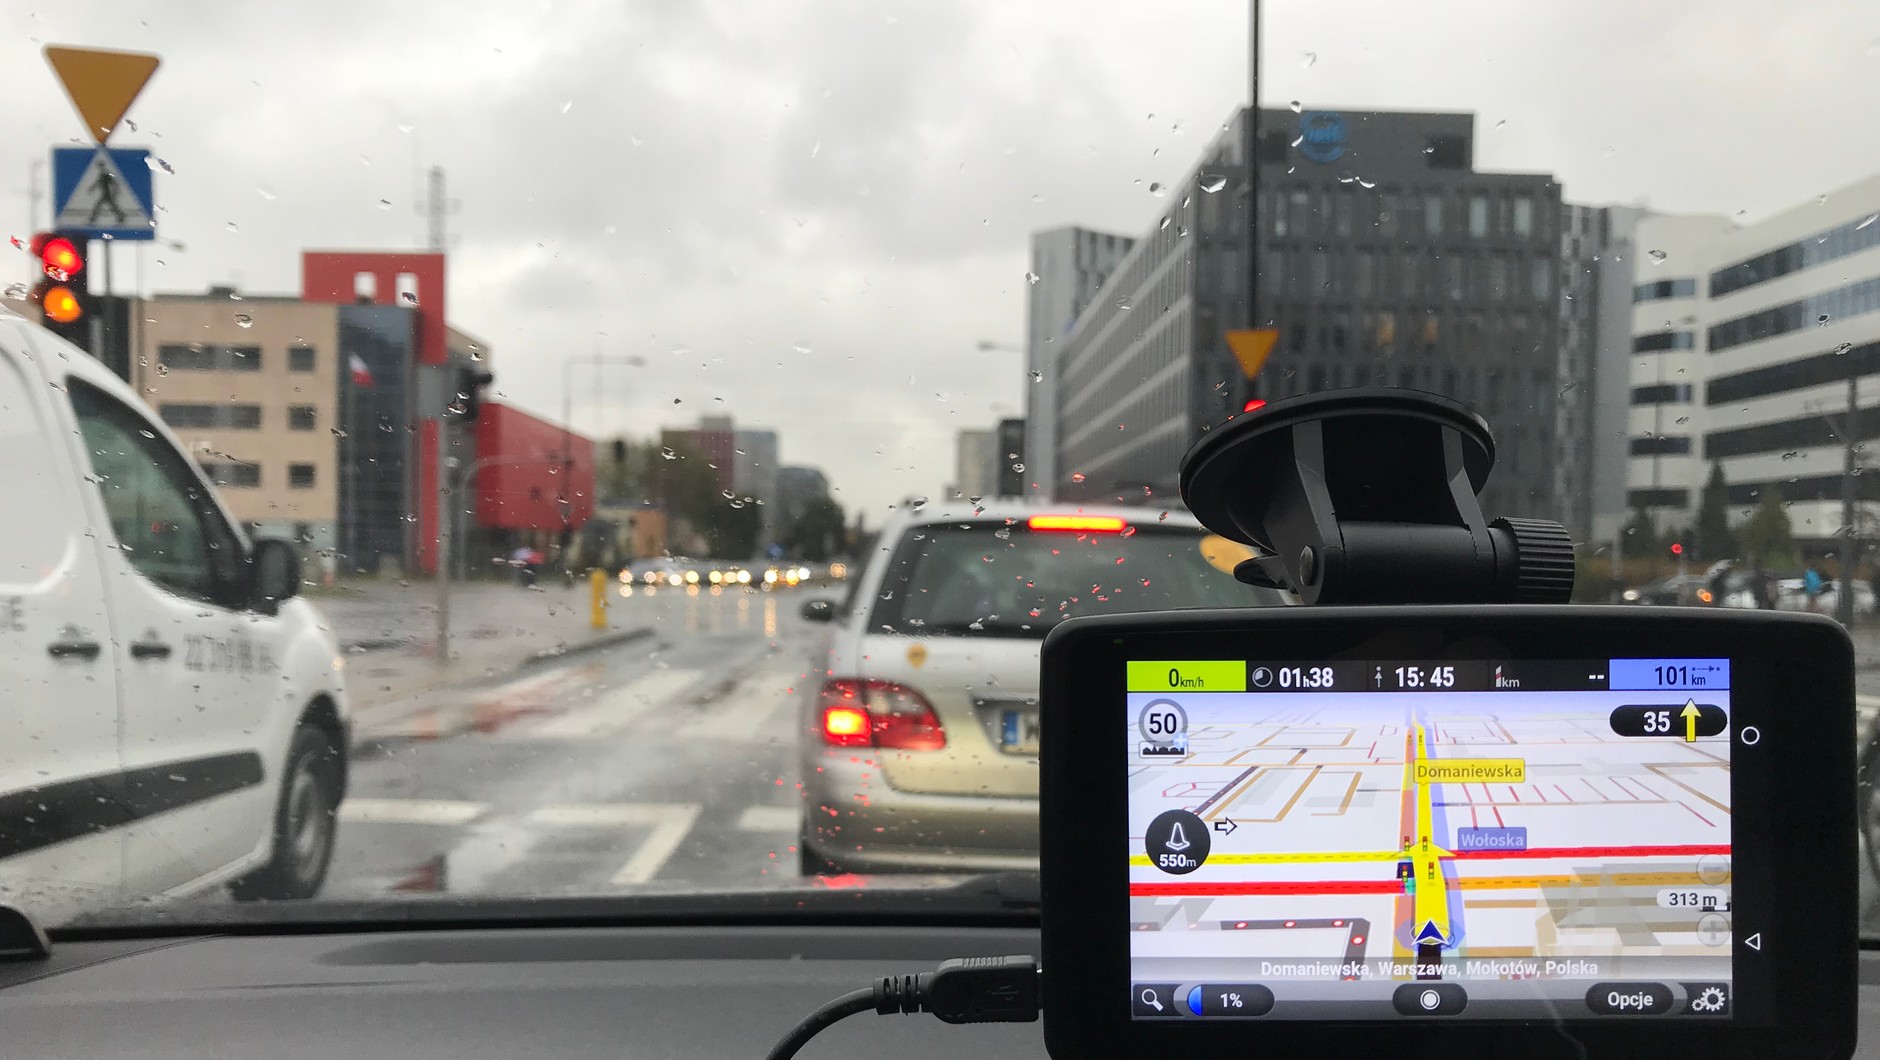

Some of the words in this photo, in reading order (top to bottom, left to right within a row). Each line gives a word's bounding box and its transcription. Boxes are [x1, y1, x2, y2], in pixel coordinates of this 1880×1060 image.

[1278, 667, 1334, 688] 01h38
[1502, 677, 1520, 688] km
[1149, 713, 1177, 734] 50
[1643, 711, 1671, 732] 35
[1417, 764, 1522, 778] Domaniewska
[1461, 833, 1524, 847] Wołoska
[1669, 892, 1698, 906] 313
[1702, 895, 1717, 906] m
[1261, 961, 1374, 977] Domaniewska,
[1378, 961, 1461, 977] Warszawa,
[1466, 959, 1542, 977] Mokotów,
[1545, 960, 1598, 975] Polska
[1220, 992, 1243, 1008] 1%
[1607, 991, 1654, 1010] Opcje
